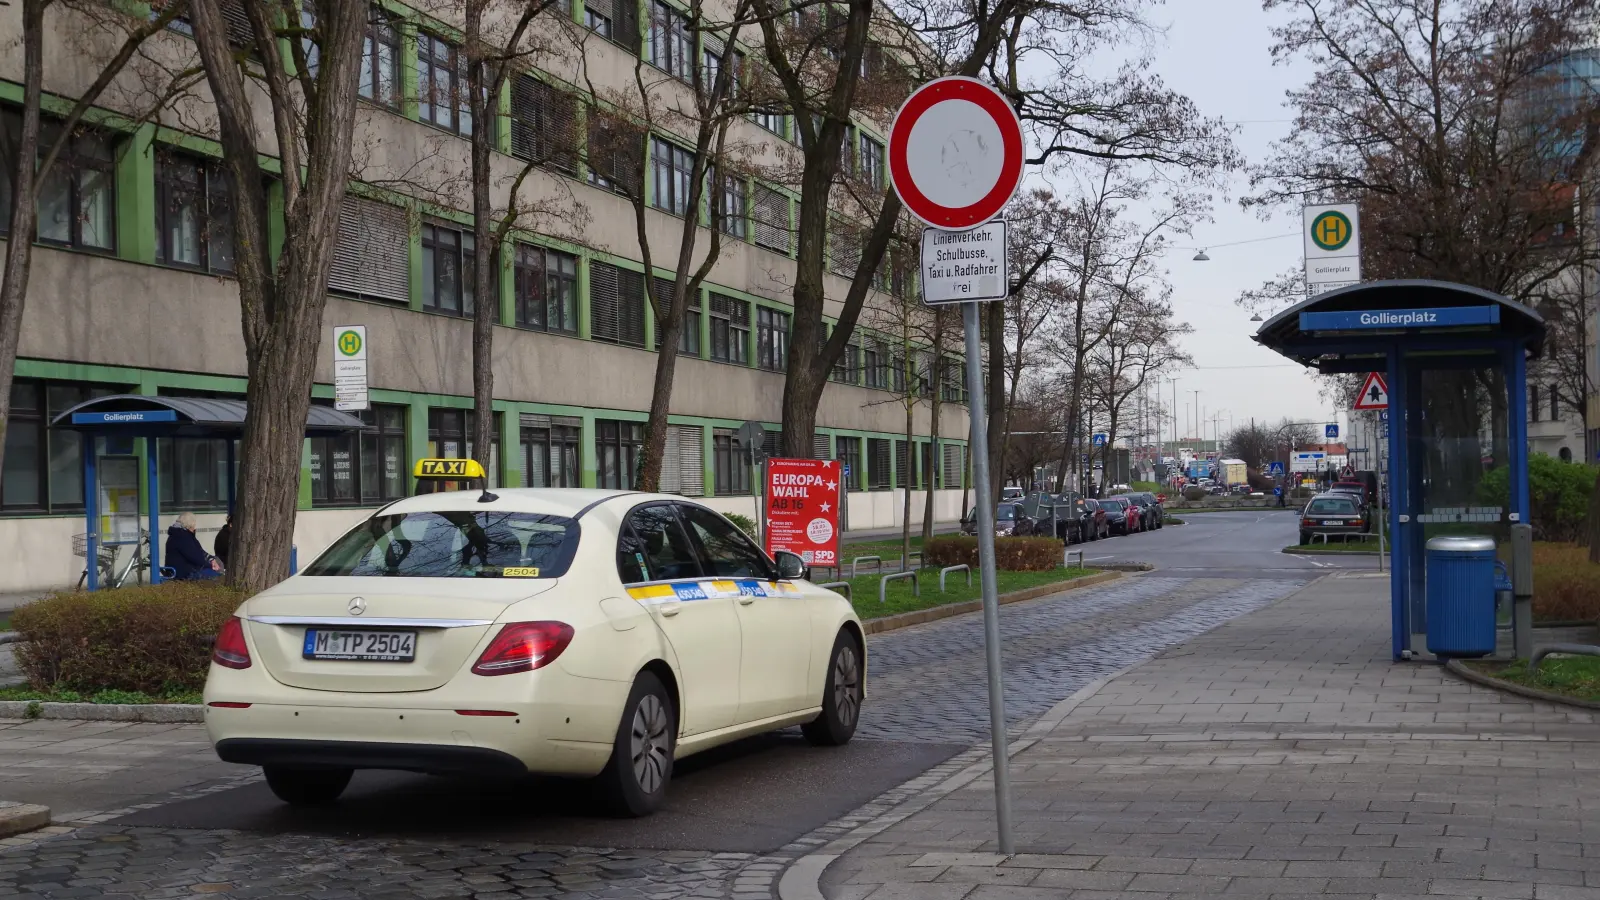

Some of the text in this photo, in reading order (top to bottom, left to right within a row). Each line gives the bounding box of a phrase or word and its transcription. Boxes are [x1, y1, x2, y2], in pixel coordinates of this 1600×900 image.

[1323, 219, 1340, 242] H
[928, 266, 944, 279] Taxi
[1315, 266, 1350, 274] Gollierplatz
[1360, 311, 1436, 325] Gollierplatz
[344, 336, 356, 351] H
[103, 413, 144, 421] Gollierplatz
[424, 462, 465, 474] TAXI
[772, 473, 826, 486] EUROPA-
[772, 486, 810, 498] WAHL
[772, 499, 804, 509] AB 16
[815, 550, 835, 560] SPD
[504, 568, 537, 576] 2504
[317, 633, 411, 654] M TP 2504
